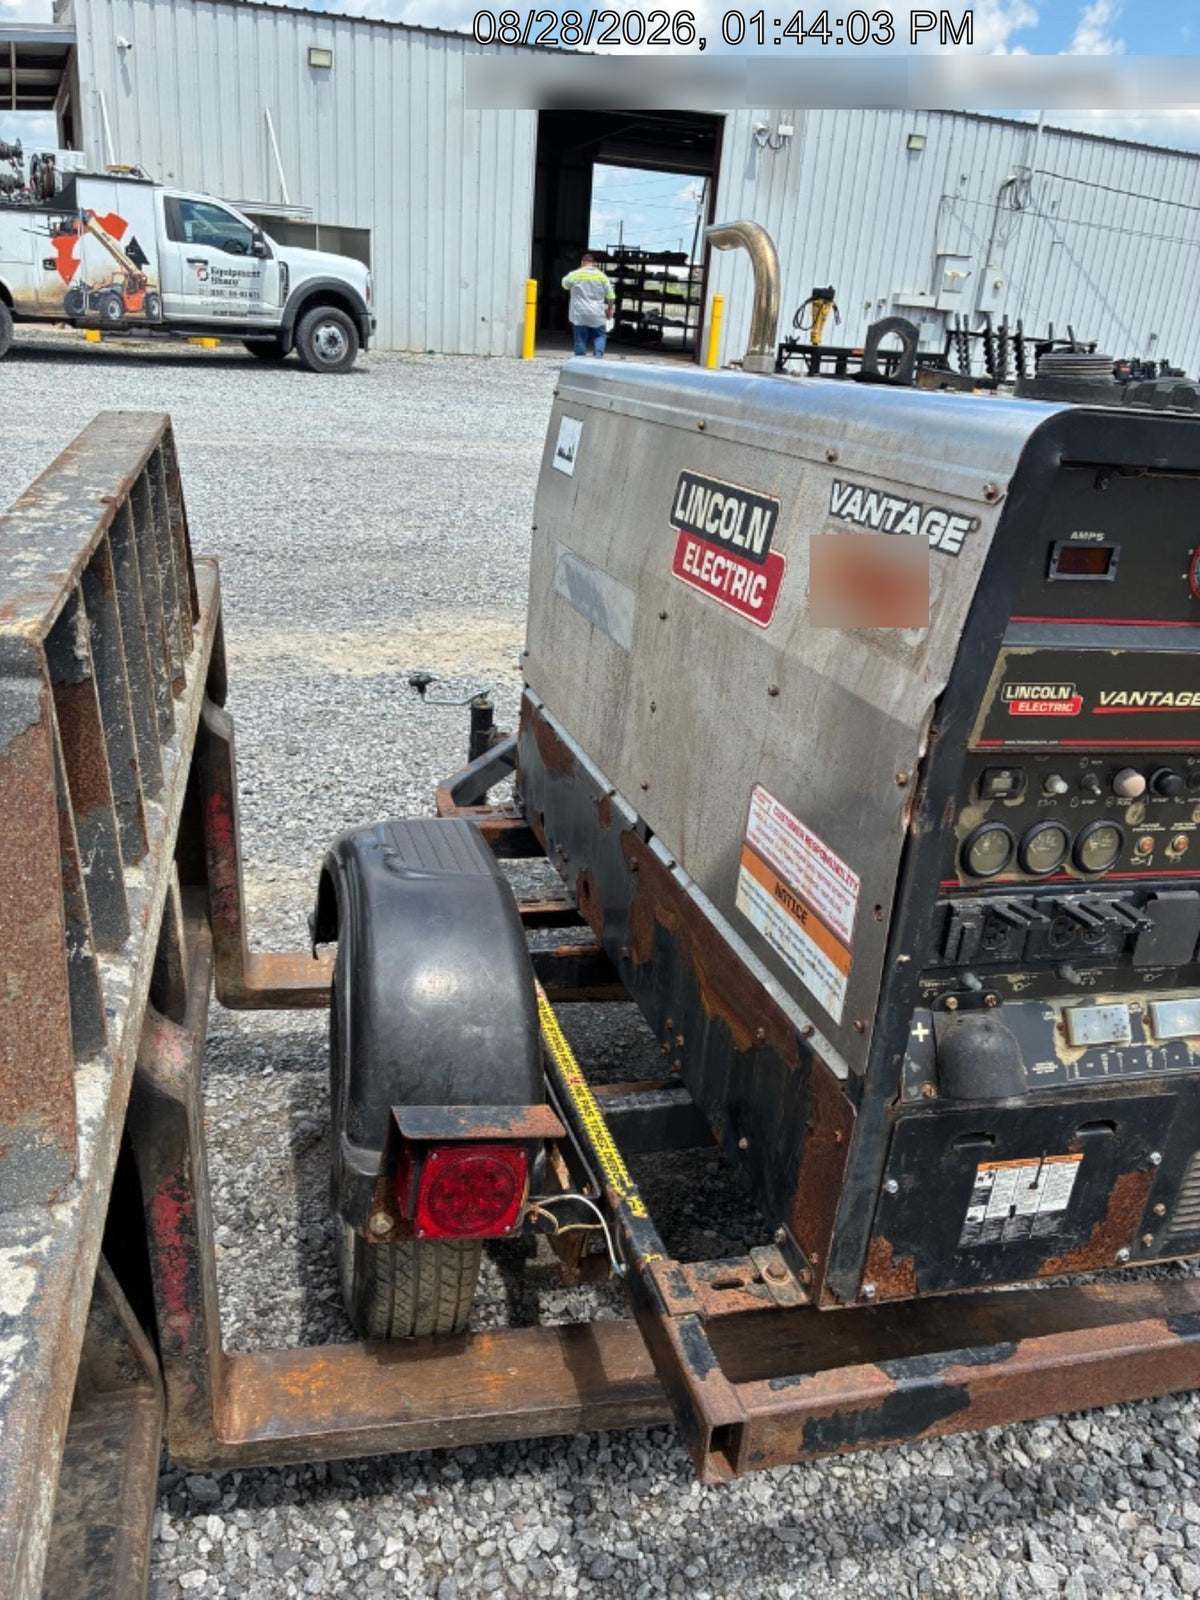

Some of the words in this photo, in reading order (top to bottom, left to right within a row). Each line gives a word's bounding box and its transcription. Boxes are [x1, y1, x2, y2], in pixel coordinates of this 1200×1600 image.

[674, 480, 772, 555] LINCOLN
[829, 479, 974, 557] VANTAGE
[1070, 530, 1105, 541] AMPS
[682, 541, 768, 609] ELECTRIC
[1006, 685, 1072, 700] LINCOLN
[1018, 700, 1075, 713] ELECTRIC
[774, 881, 808, 926] NOTICE
[580, 1097, 595, 1119] PAS
